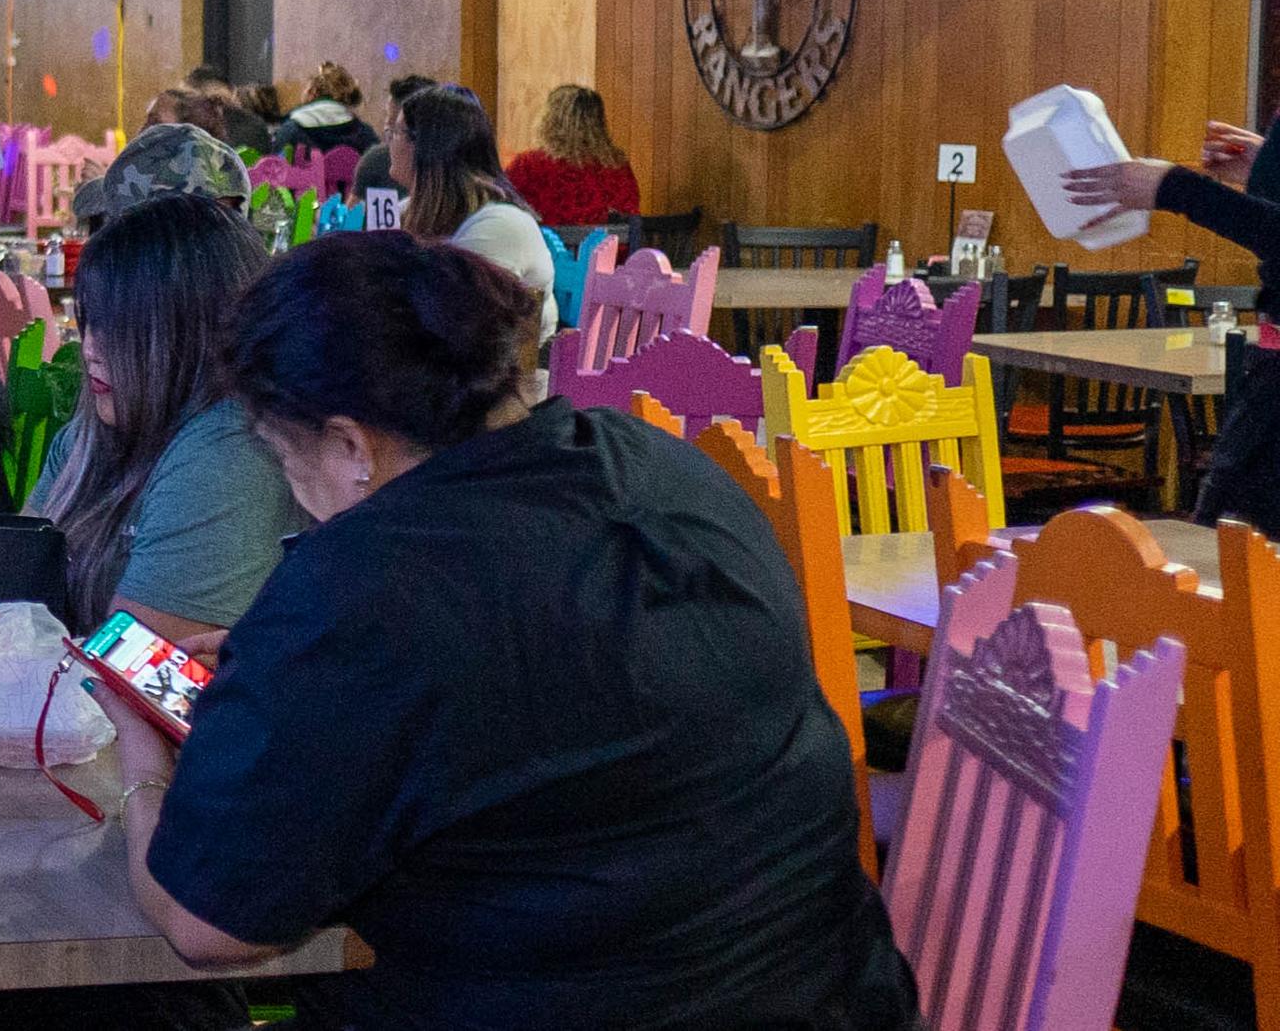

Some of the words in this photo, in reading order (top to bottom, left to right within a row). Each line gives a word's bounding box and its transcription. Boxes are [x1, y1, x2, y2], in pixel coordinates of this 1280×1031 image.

[692, 11, 846, 123] RANGERS
[951, 152, 964, 175] 2
[372, 196, 395, 228] 16
